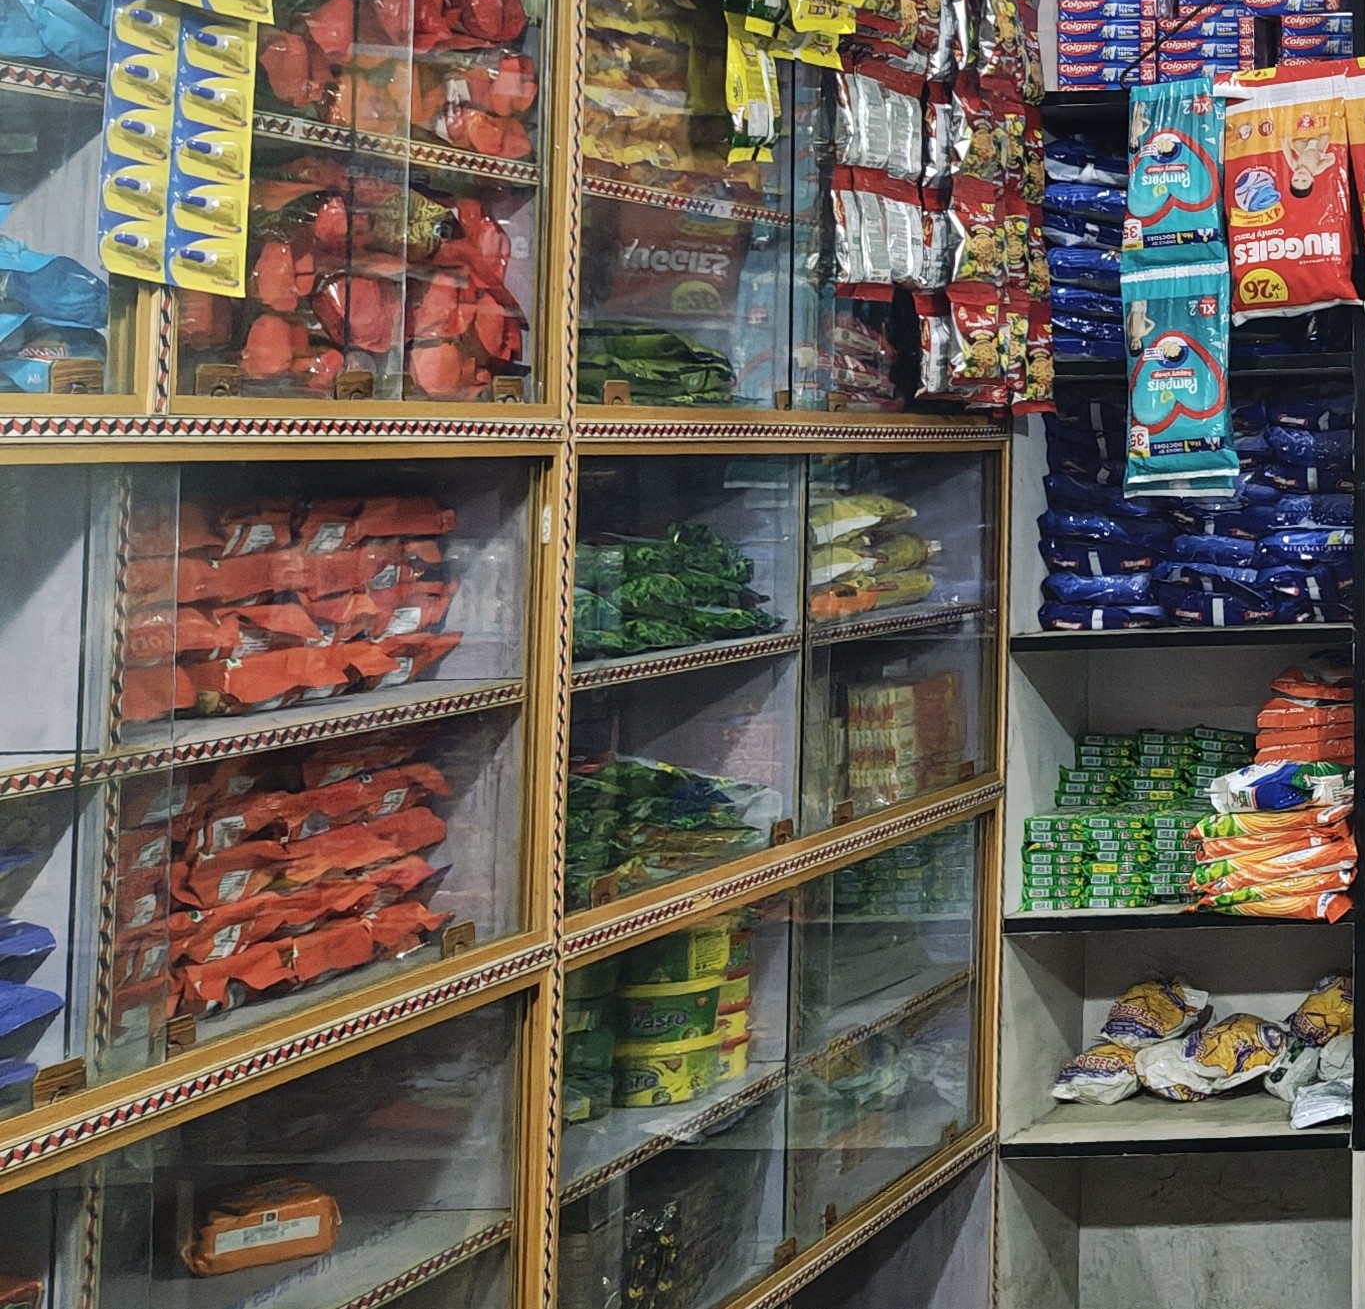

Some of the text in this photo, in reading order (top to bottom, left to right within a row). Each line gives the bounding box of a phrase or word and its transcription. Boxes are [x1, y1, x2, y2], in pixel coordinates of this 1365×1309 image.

[1257, 228, 1284, 239] Comfy
[1234, 231, 1341, 266] HUGGIES
[1148, 379, 1197, 394] Pampers
